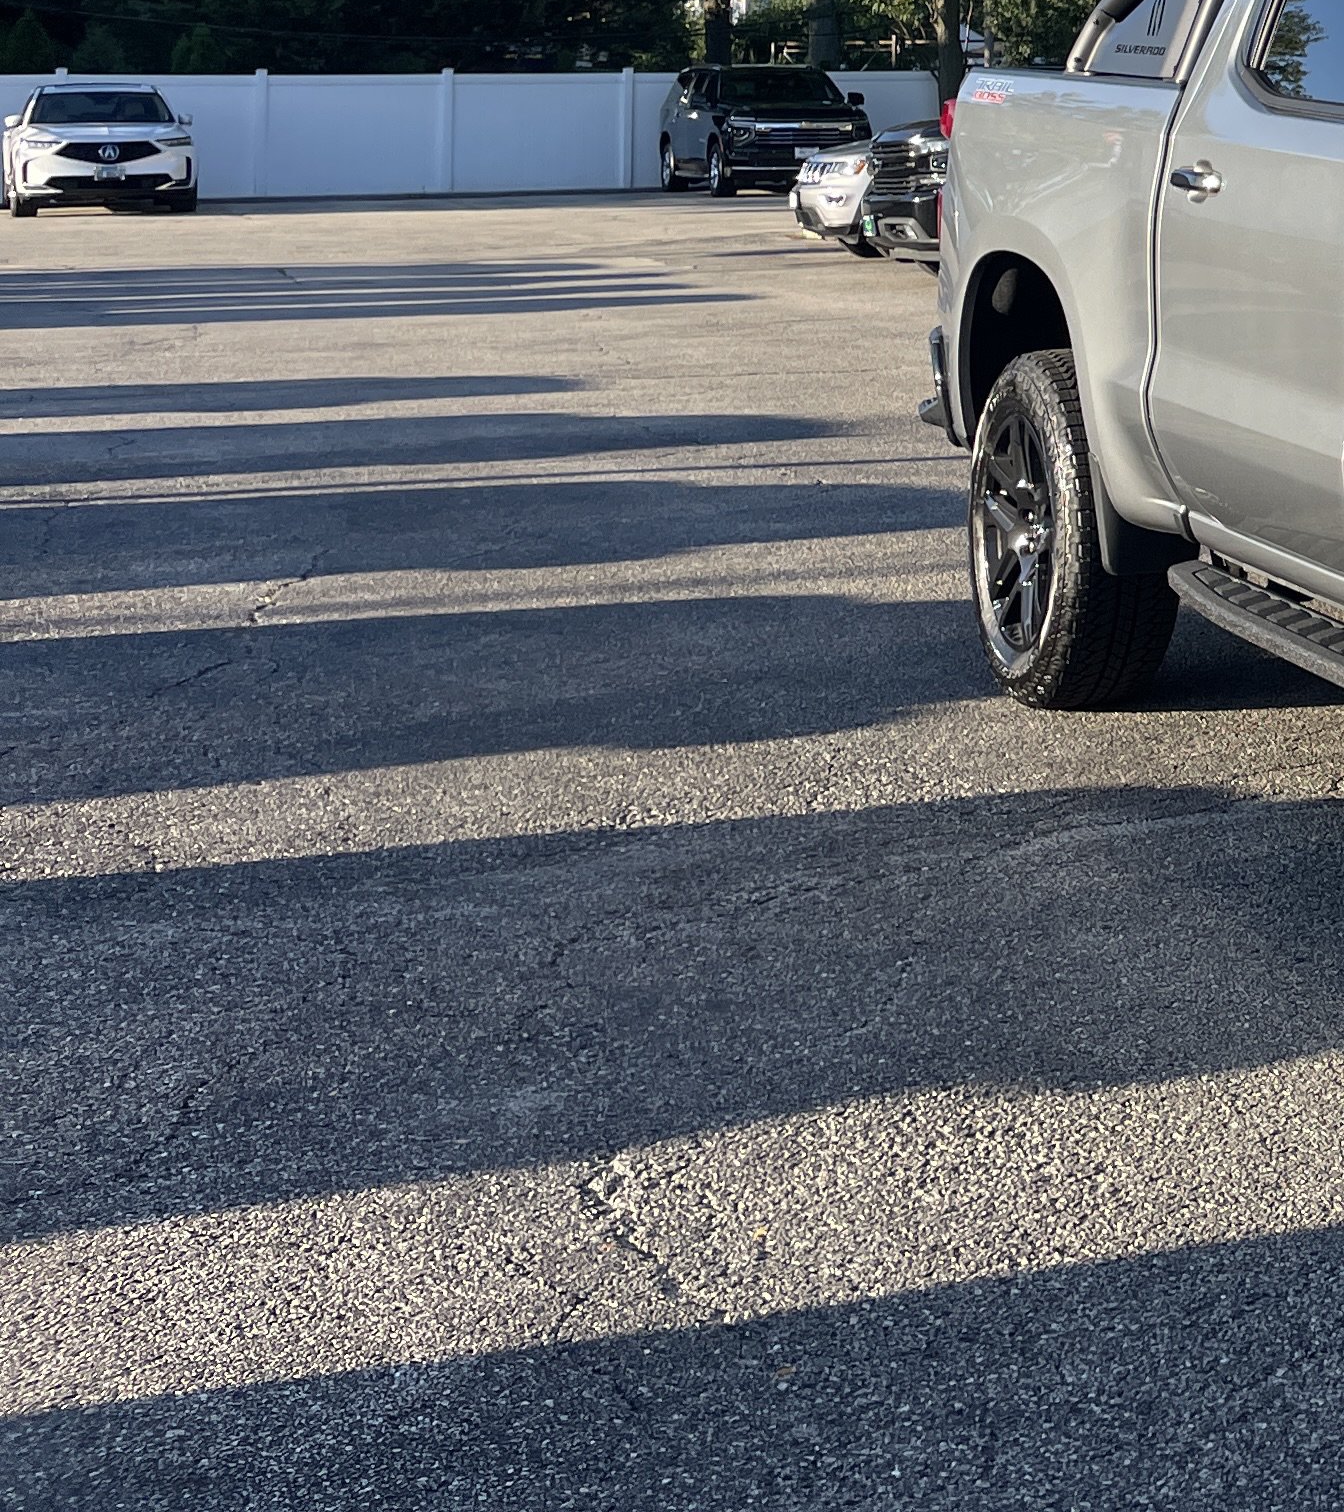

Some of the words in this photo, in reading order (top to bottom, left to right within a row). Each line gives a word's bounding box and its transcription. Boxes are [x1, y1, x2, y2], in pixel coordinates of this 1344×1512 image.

[1115, 44, 1166, 56] SILVERADO
[976, 78, 1014, 95] TRAIL
[973, 90, 1006, 104] BOSS
